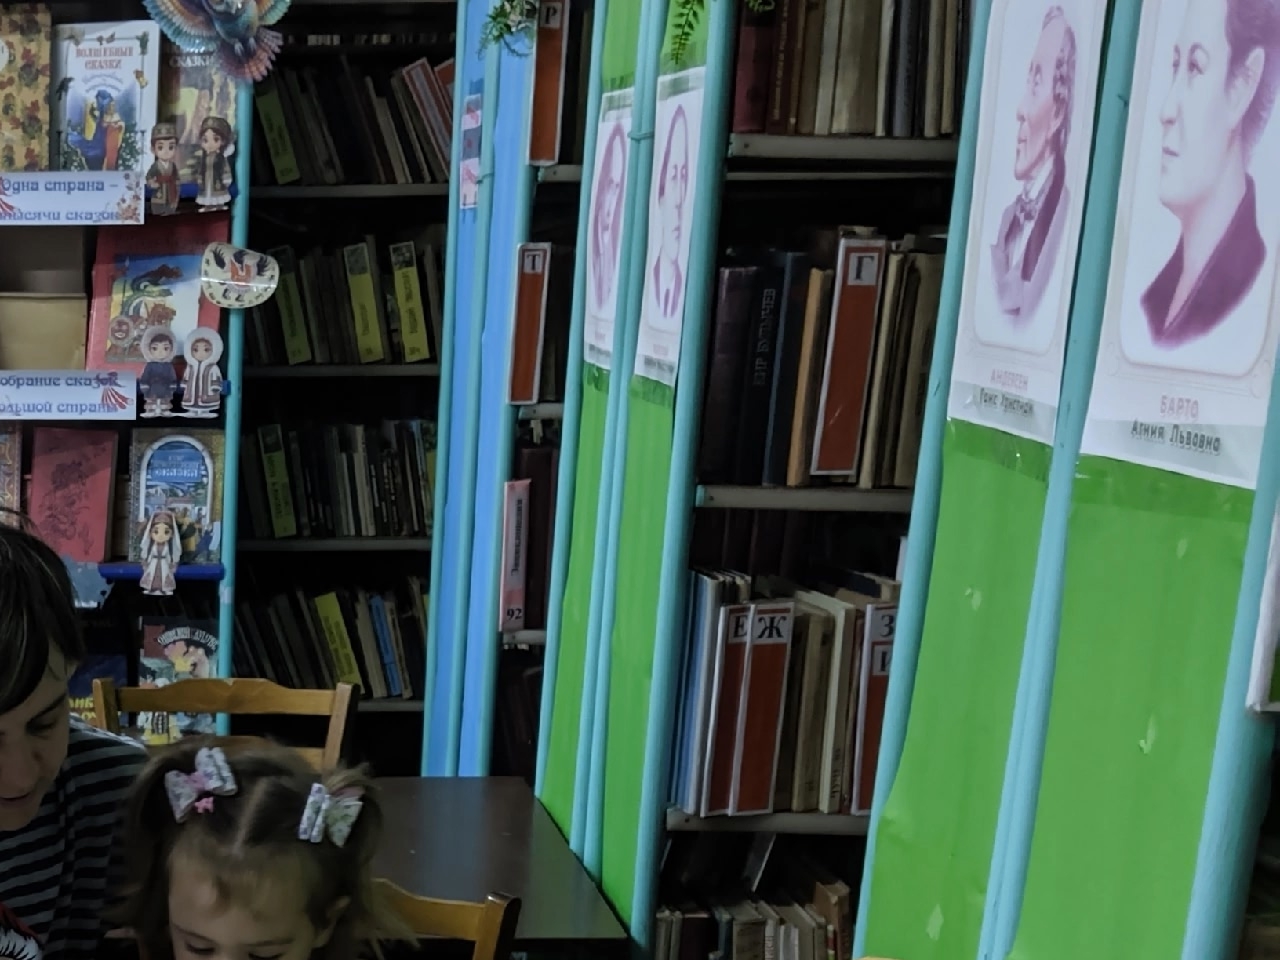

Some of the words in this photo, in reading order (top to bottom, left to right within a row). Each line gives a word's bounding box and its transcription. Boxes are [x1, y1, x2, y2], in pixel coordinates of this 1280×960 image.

[1, 178, 39, 195] Одна
[44, 180, 105, 195] страна
[853, 255, 875, 281] Г
[1160, 394, 1200, 422] БАРТО
[1130, 419, 1165, 441] Агния
[1169, 423, 1222, 457] Львовна
[506, 608, 522, 620] 92
[757, 615, 787, 639] Ж
